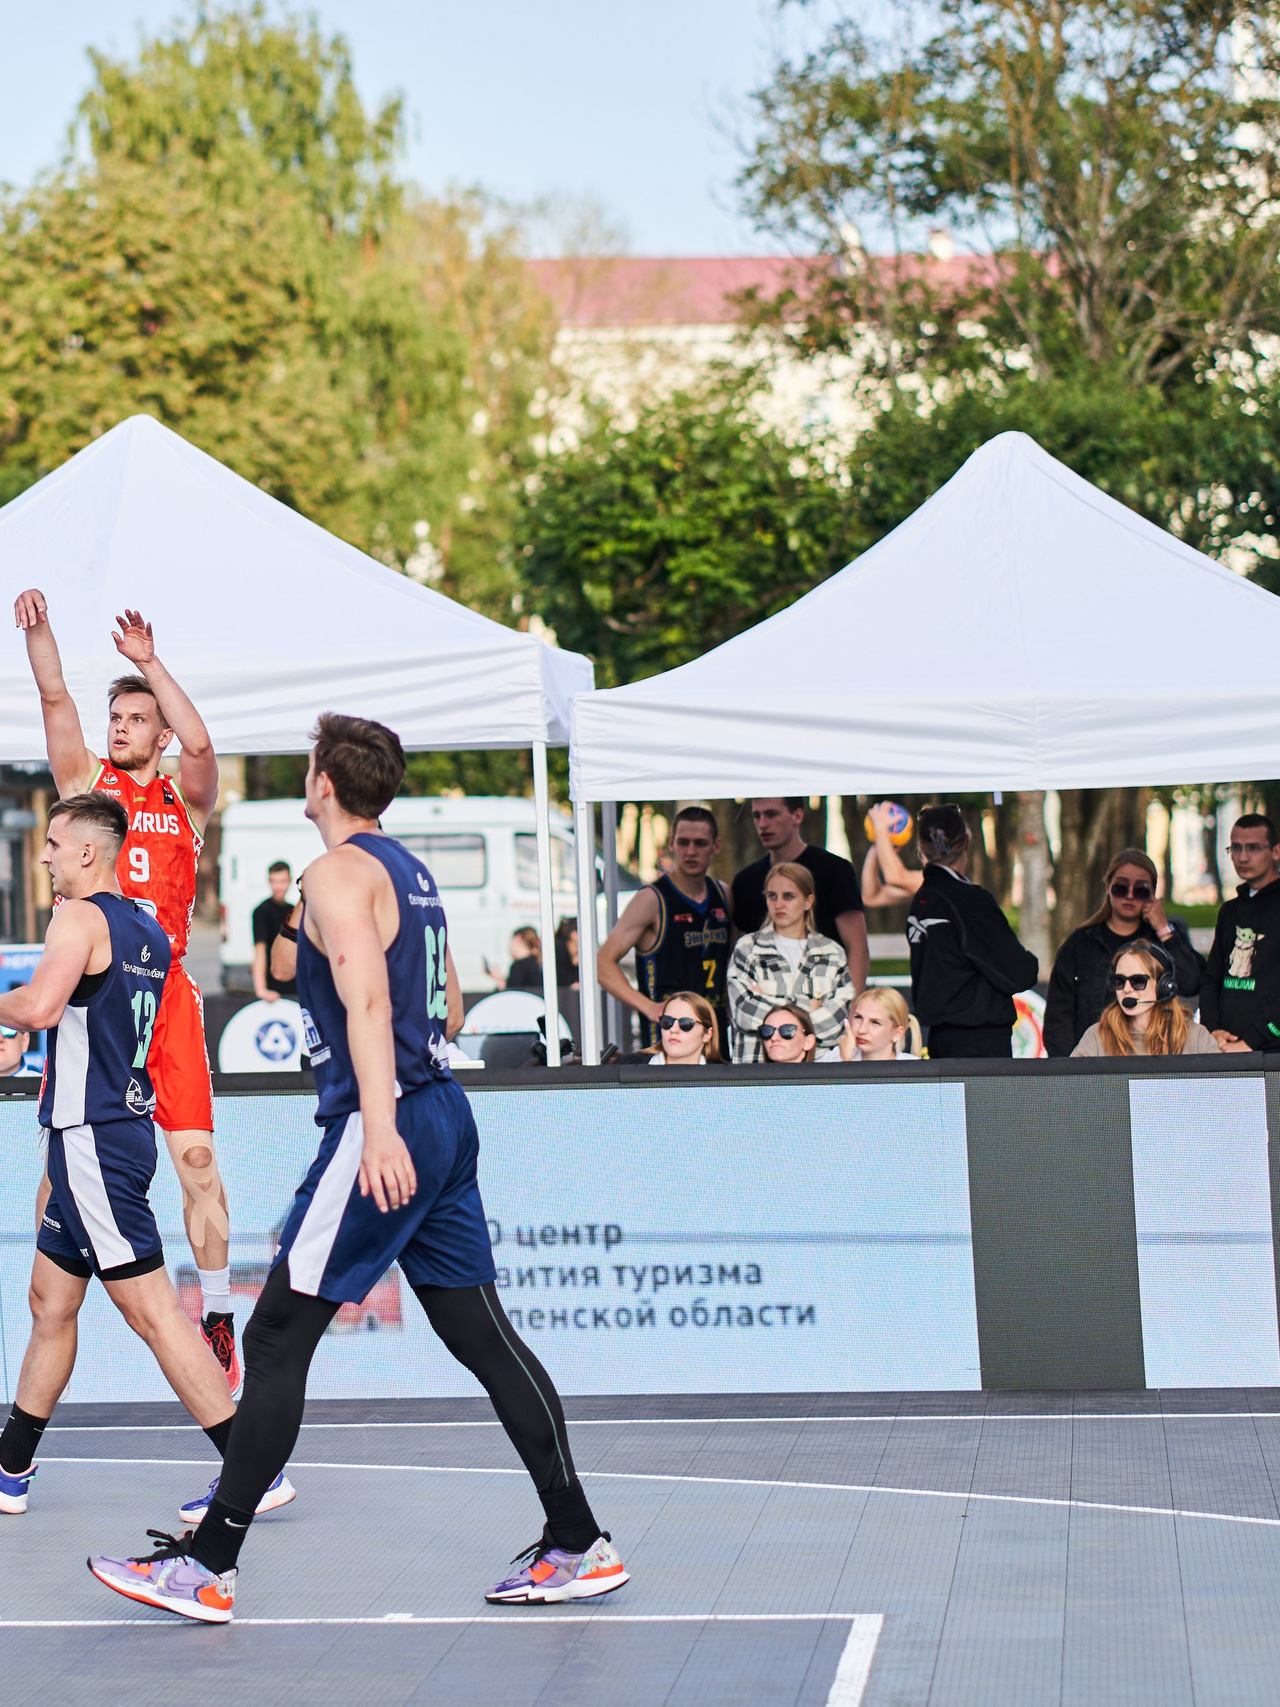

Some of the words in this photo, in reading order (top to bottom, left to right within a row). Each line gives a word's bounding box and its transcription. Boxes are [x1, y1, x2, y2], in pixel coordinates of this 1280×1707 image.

[127, 811, 180, 835] ARUS
[128, 846, 150, 883] 9
[702, 959, 717, 988] 7
[131, 990, 156, 1069] 13
[517, 1224, 622, 1253] центр
[496, 1266, 600, 1288] вития
[612, 1264, 763, 1294] туризма
[507, 1298, 656, 1330] ленской
[669, 1296, 816, 1327] области
